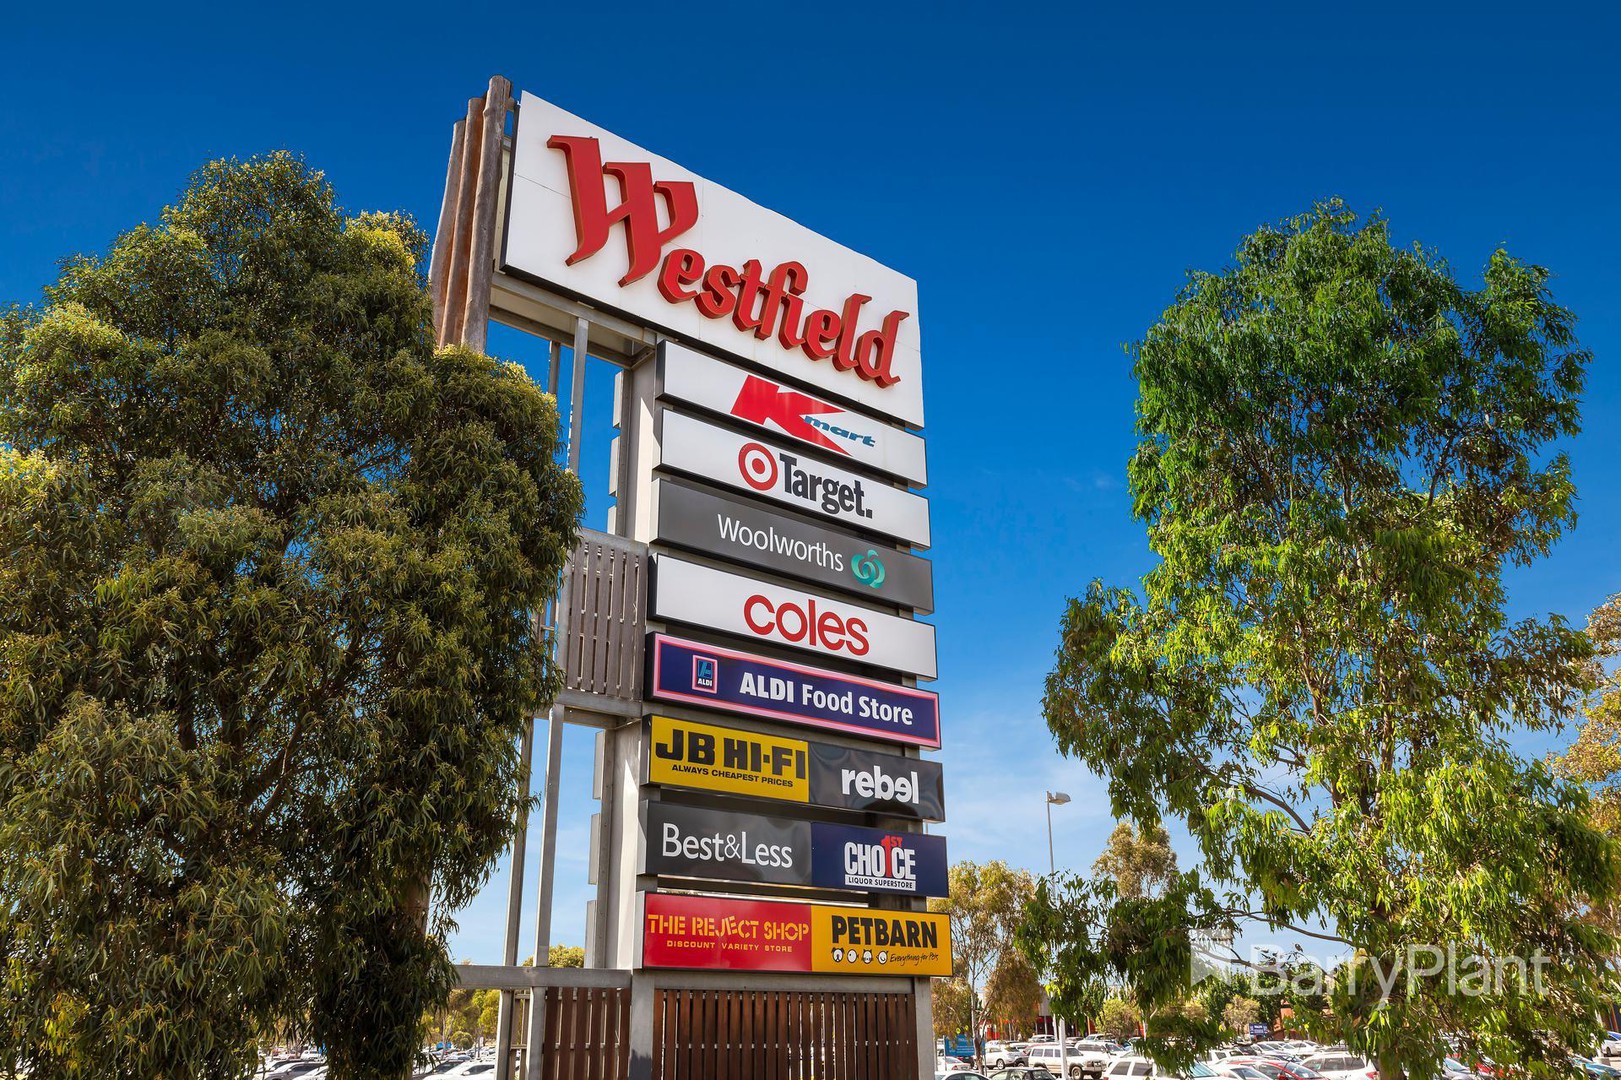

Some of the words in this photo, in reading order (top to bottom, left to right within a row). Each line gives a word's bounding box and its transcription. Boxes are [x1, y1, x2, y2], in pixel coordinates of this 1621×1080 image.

[546, 135, 909, 388] Westfield
[731, 375, 875, 456] Kmart
[717, 513, 844, 572] Woolworths
[743, 594, 870, 656] coles
[697, 678, 713, 687] ALDI
[739, 672, 795, 703] ALDI
[802, 683, 853, 715] Food
[858, 695, 913, 726] Store
[655, 728, 715, 766] JB
[723, 737, 806, 780] HI-FI
[672, 764, 709, 775] ALWAYS
[711, 769, 760, 783] CHEAPEST
[761, 776, 793, 788] PRICES
[841, 765, 919, 804] rebel
[662, 822, 793, 869] Best&Less
[848, 876, 873, 886] LIQUOR
[874, 878, 913, 889] SUPERSTORE
[647, 914, 686, 935] THE
[691, 915, 759, 939] REJECT
[763, 921, 809, 941] SHOP
[666, 940, 715, 949] DISCOUNT
[721, 943, 760, 951] VARIETY
[831, 915, 938, 949] PETBARN
[890, 953, 919, 966] Everything
